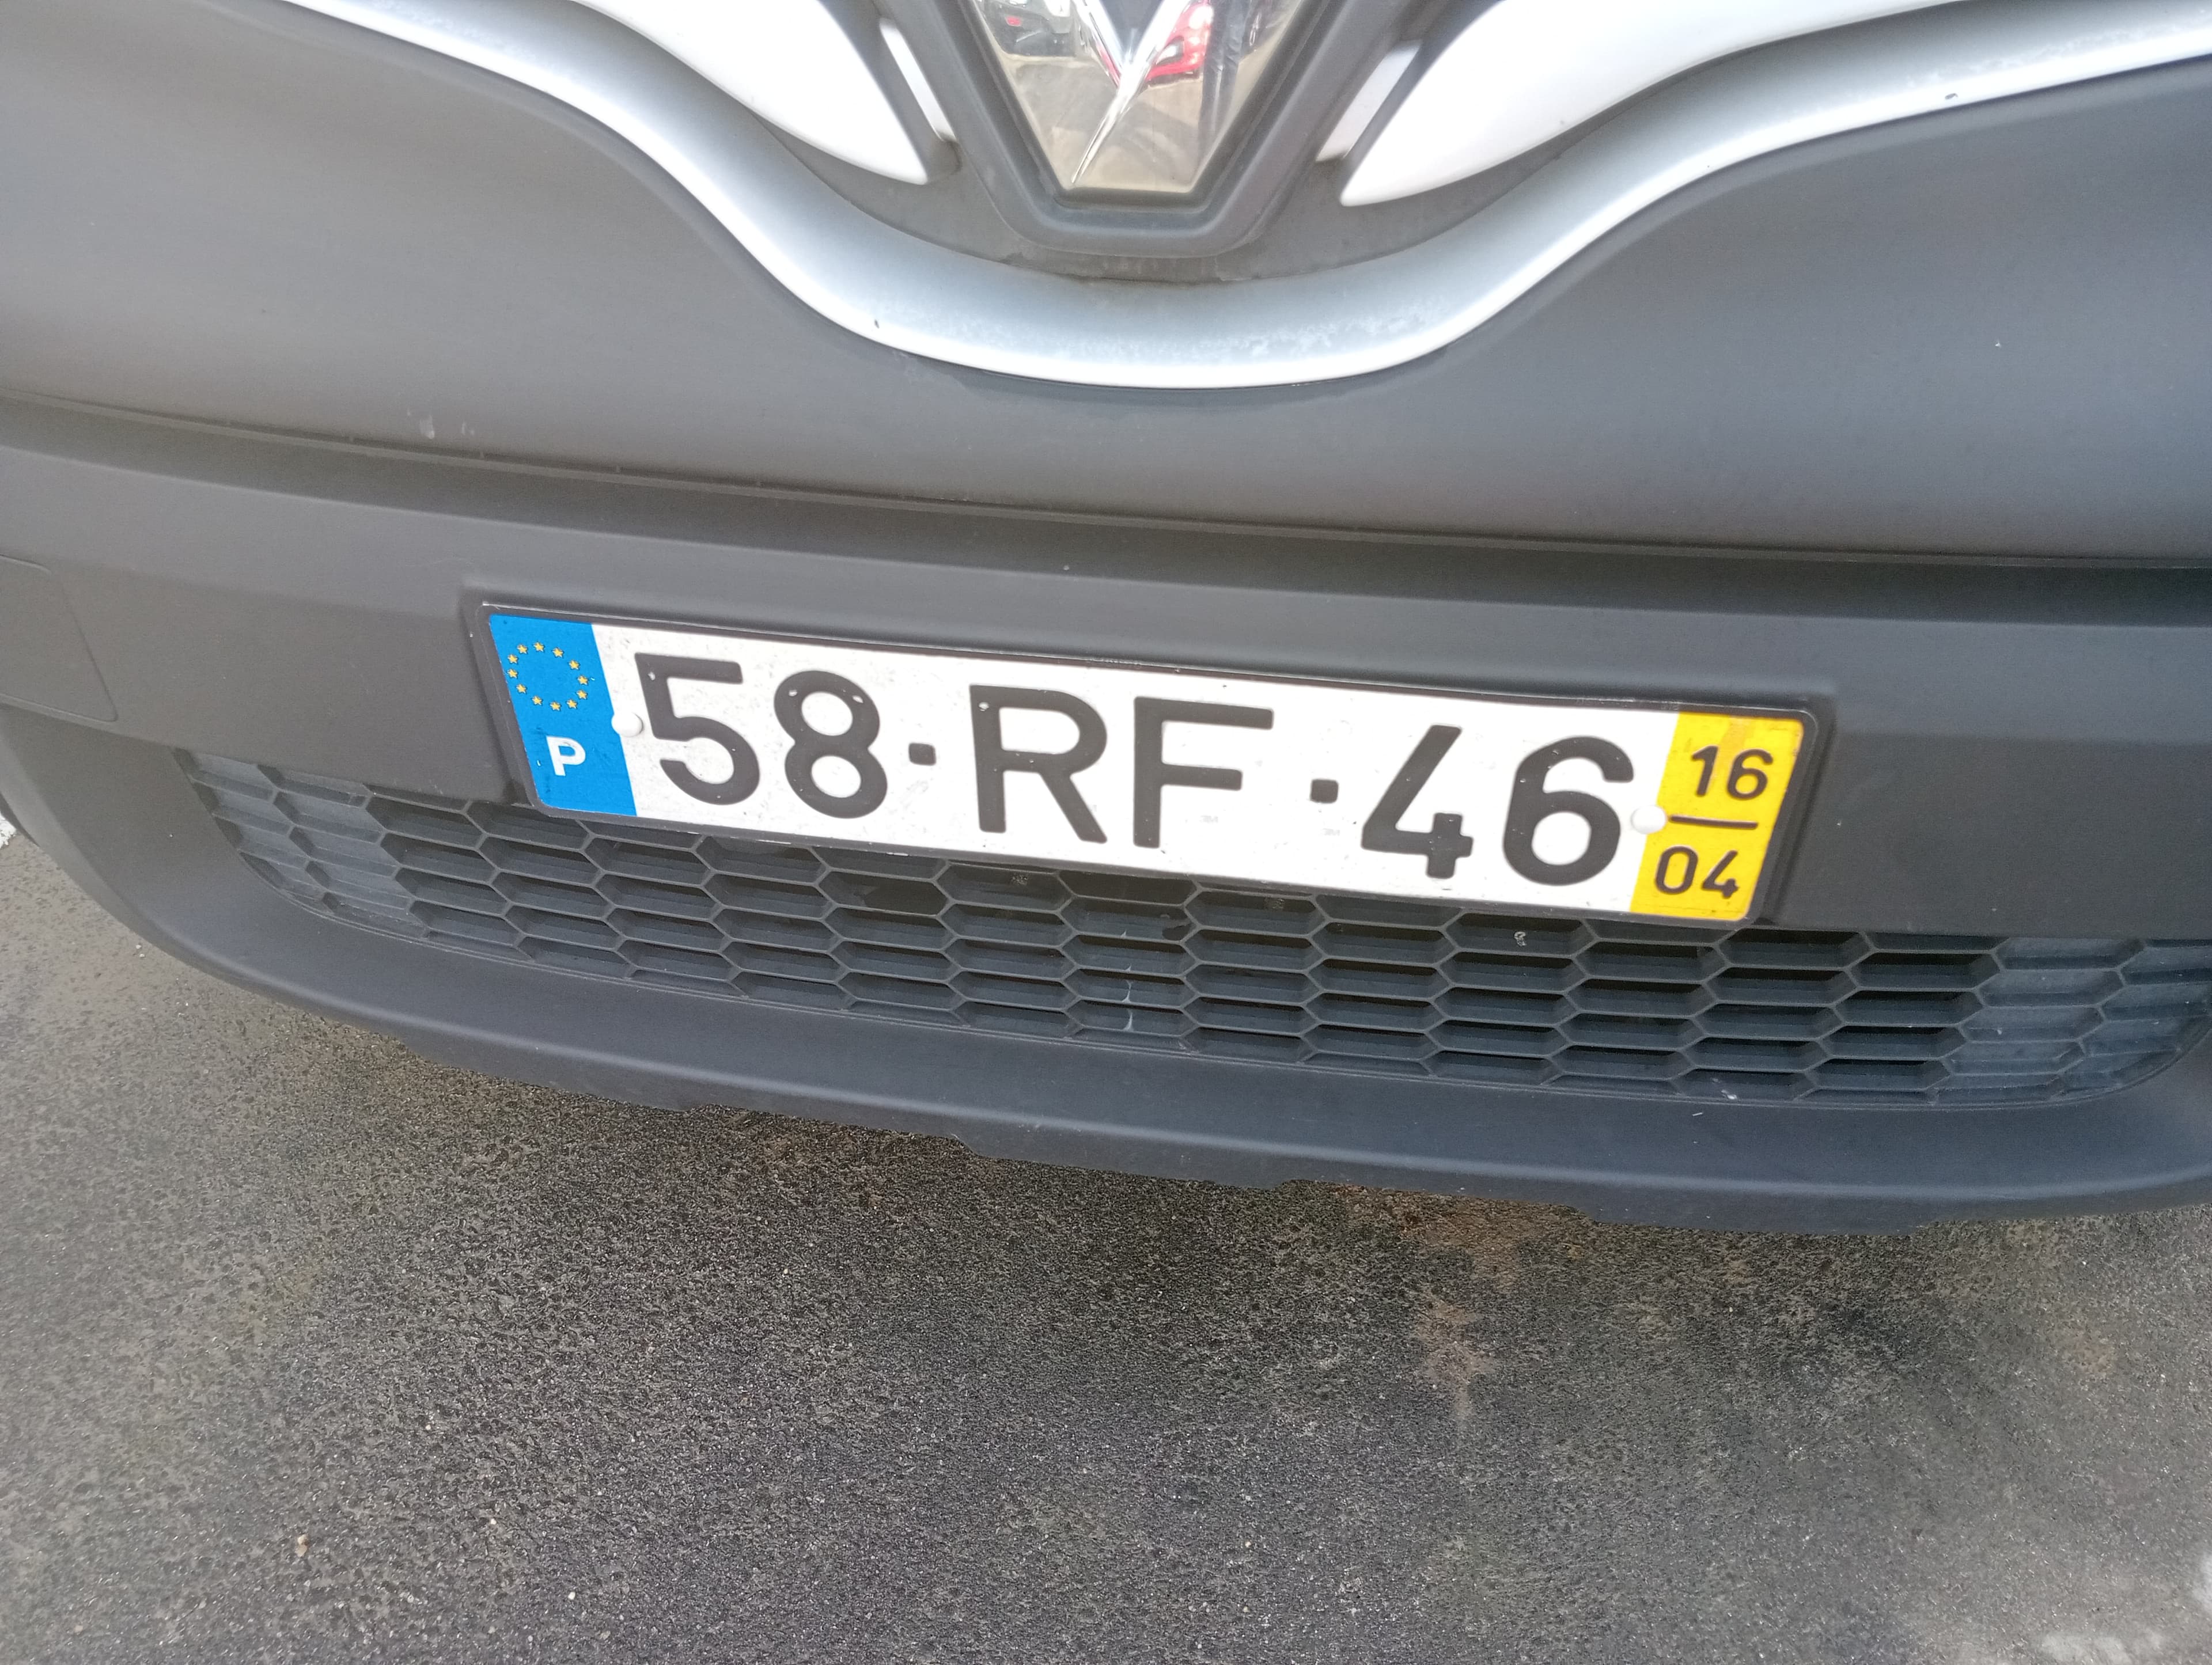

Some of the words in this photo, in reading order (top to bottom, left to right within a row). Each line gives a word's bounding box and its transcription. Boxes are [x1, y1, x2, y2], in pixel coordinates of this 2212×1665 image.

[547, 736, 585, 776] P
[1691, 745, 1773, 800] 16
[1655, 847, 1738, 898] 04
